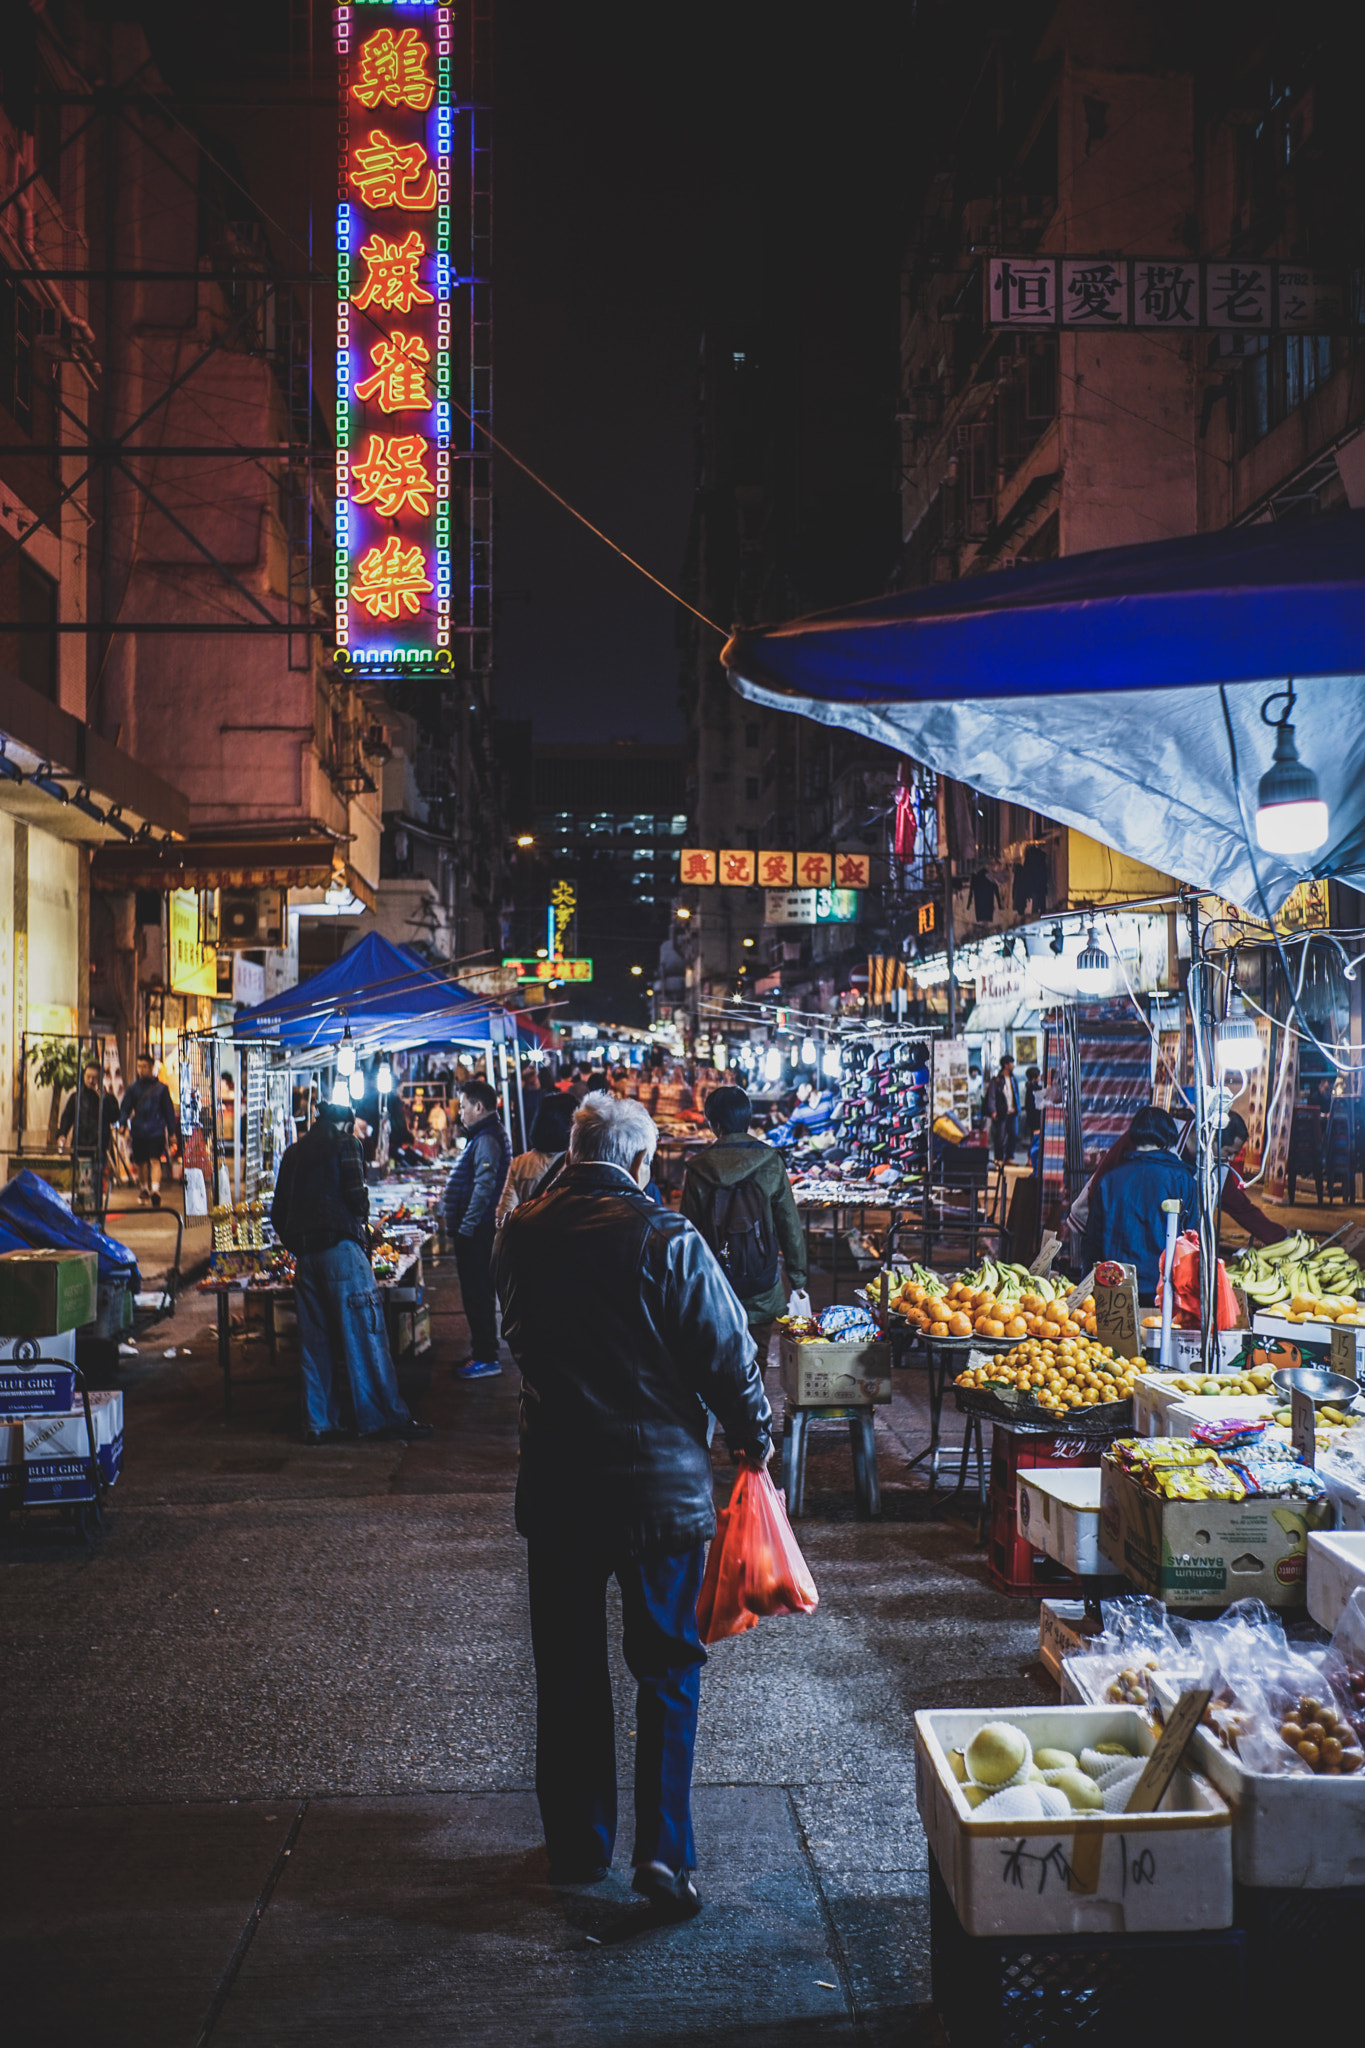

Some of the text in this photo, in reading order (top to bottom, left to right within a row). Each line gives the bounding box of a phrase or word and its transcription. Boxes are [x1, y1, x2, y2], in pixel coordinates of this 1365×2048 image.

[684, 852, 868, 886] 興記煲仔飯
[1108, 1290, 1127, 1316] 10
[1338, 1333, 1349, 1357] 15
[28, 1379, 56, 1388] GIRL
[24, 1420, 65, 1453] IMPORTED
[28, 1464, 88, 1476] BLUE GIRL
[1168, 1557, 1224, 1567] BANANAS
[1175, 1568, 1223, 1580] Premium
